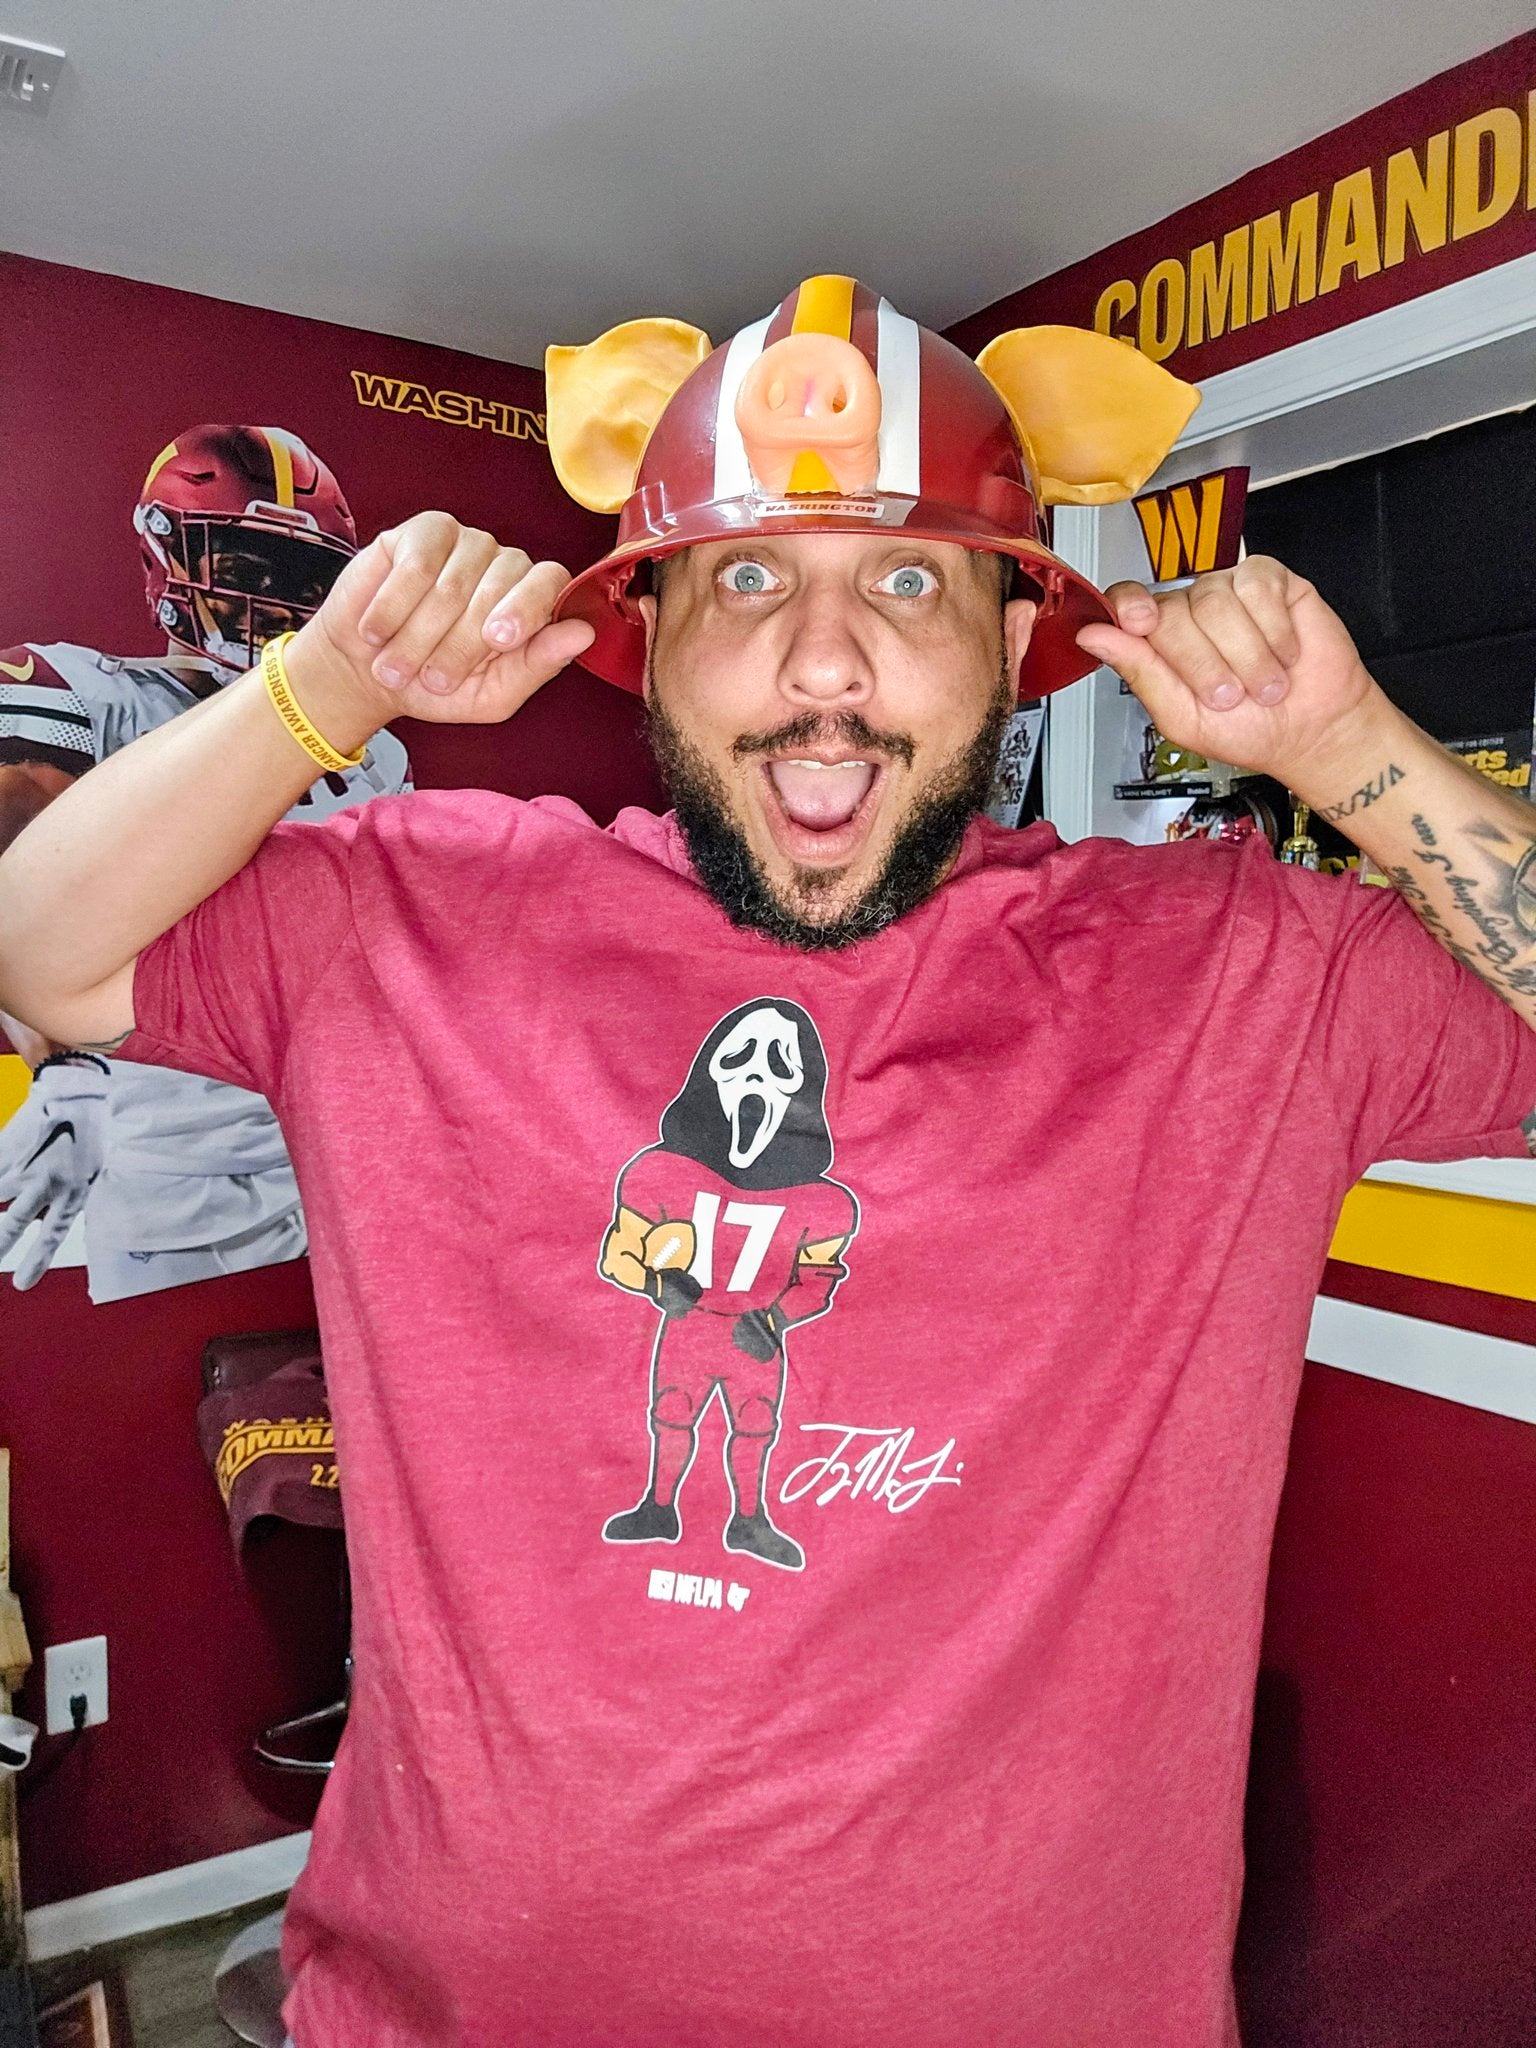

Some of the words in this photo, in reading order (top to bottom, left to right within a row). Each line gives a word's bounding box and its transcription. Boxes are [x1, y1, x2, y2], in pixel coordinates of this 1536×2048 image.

[1094, 88, 1536, 362] COMMAND
[765, 503, 878, 514] WASHINGTON
[1134, 473, 1227, 582] W
[266, 657, 308, 733] AWARENESS
[302, 734, 343, 769] CANCER
[1141, 788, 1172, 796] HELMET
[688, 1190, 787, 1293] 17
